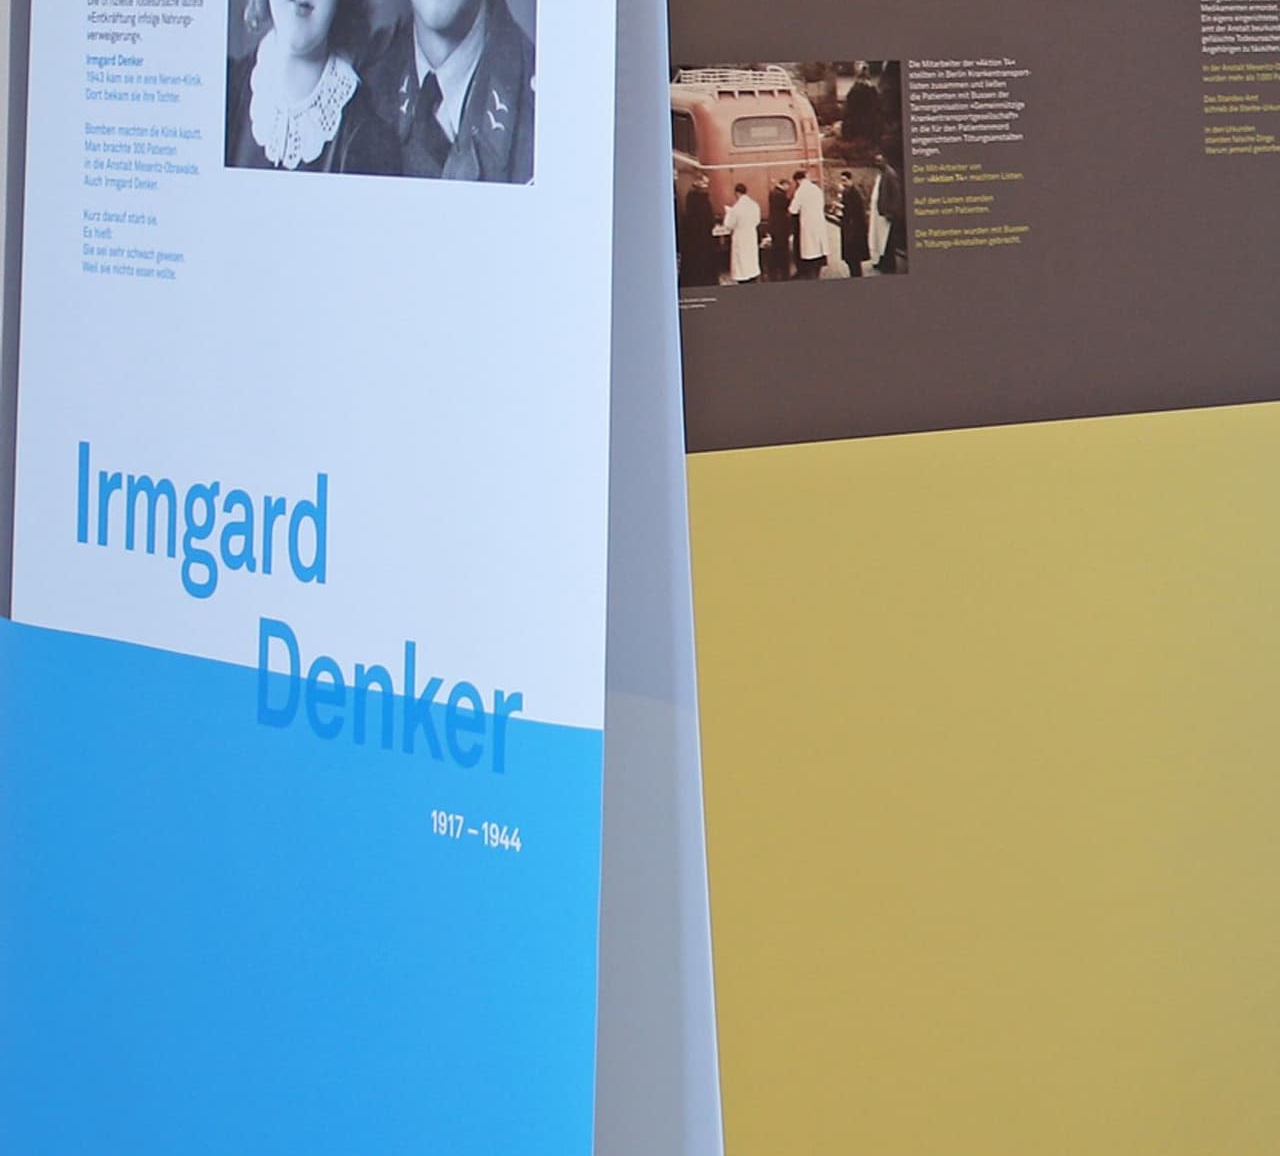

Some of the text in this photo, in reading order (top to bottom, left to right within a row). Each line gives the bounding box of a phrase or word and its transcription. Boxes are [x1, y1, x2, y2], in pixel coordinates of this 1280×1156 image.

[77, 441, 328, 598] Irmgard
[257, 617, 523, 774] Denker
[431, 809, 464, 839] 1917
[481, 822, 523, 852] 1944
